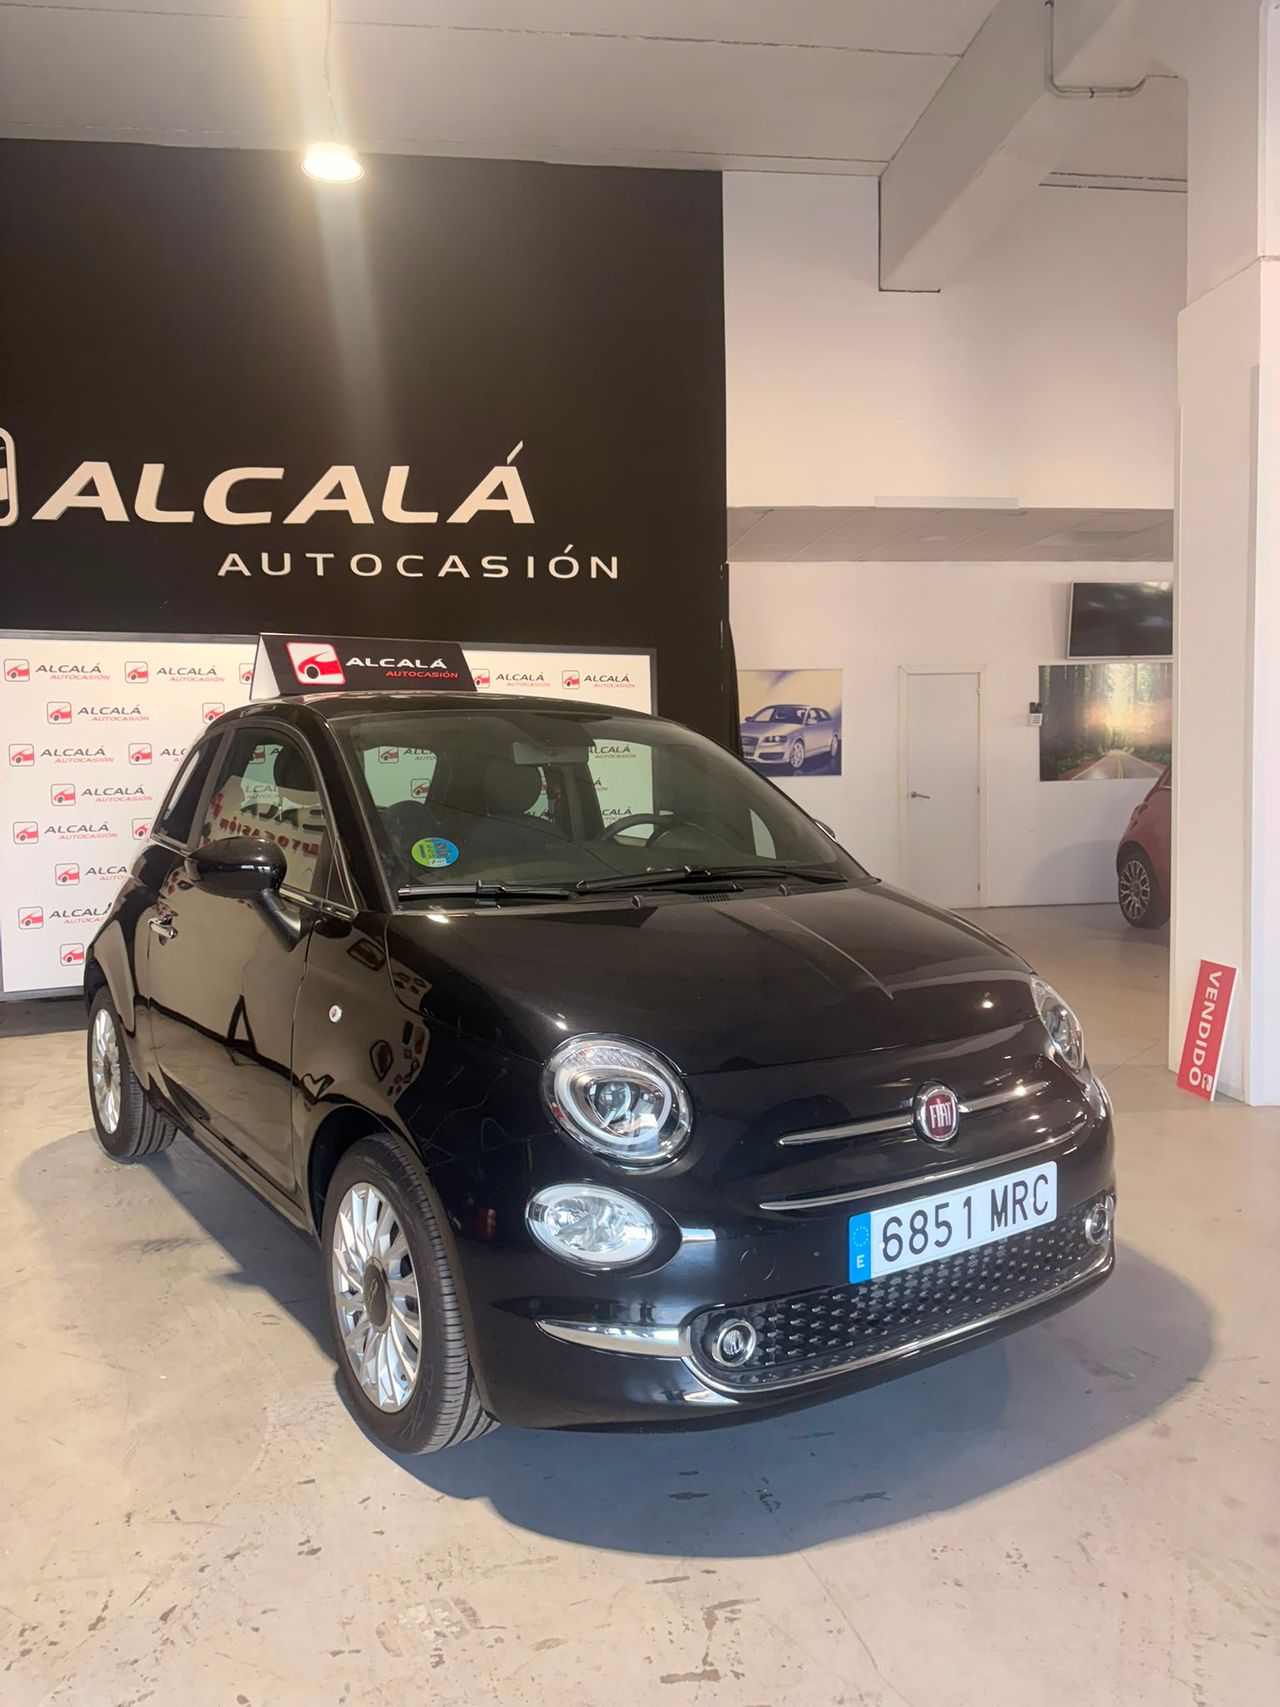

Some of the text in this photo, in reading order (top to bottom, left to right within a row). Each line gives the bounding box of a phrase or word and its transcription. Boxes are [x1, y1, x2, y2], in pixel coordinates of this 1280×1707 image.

[32, 440, 535, 525] ALCALÁ
[218, 544, 619, 580] AUTOCASIÓN
[35, 662, 102, 674] ALCALÁ
[345, 657, 448, 669] ALCALÁ
[156, 665, 217, 676] ALCALÁ
[385, 670, 459, 679] AUTOCASIÓN
[50, 673, 111, 681] AUTOCASIÓN
[495, 672, 545, 682] ALCALÁ
[583, 674, 630, 683] ALCALÁ
[77, 704, 142, 716] ALCALÁ
[40, 745, 106, 757] ALCALÁ
[160, 747, 188, 757] ALC
[81, 784, 145, 797] ALCALÁ
[602, 806, 633, 816] CALÁ
[44, 821, 110, 834] ALCALÁ
[58, 833, 118, 841] AUTOCASIÓN
[85, 866, 128, 876] ALCA
[1188, 970, 1223, 1087] VENDIDO
[929, 1101, 952, 1129] FIAT
[882, 1173, 1049, 1263] 6851 MRC
[856, 1254, 865, 1269] E
